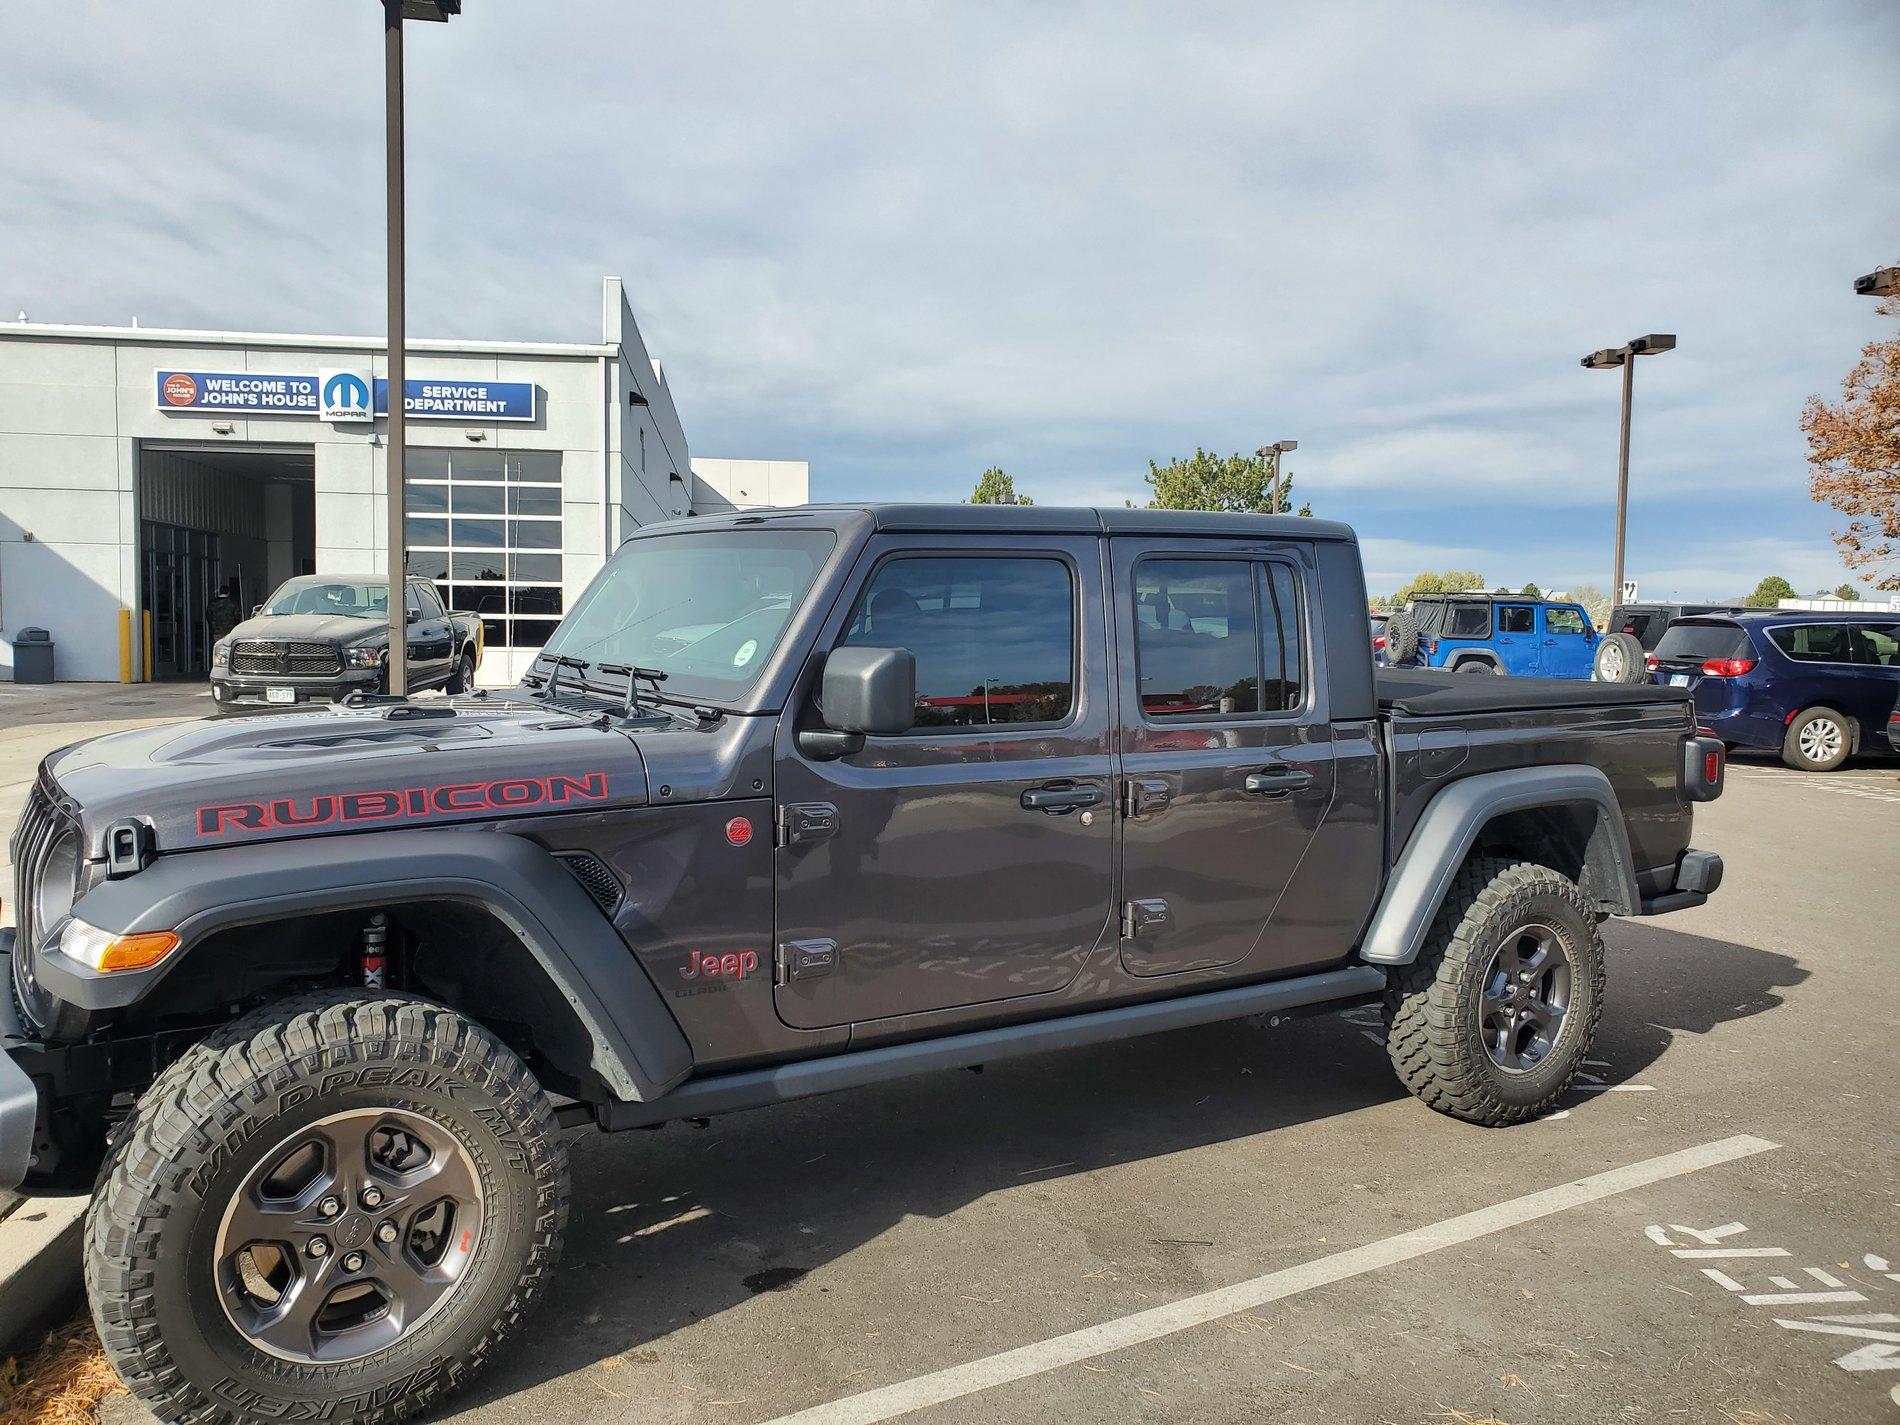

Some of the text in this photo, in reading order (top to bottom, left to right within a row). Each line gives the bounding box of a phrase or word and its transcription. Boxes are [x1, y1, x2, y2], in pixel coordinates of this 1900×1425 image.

[205, 379, 311, 394] WELCOME TO
[422, 386, 488, 399] SERVICE
[201, 392, 317, 407] JOHN'S HOUSE
[404, 398, 507, 412] DEPARTMENT
[196, 772, 608, 836] RUBICON
[678, 950, 759, 982] Jeep
[189, 1065, 467, 1200] WILDPEAK
[210, 1354, 443, 1420] FALKEN
